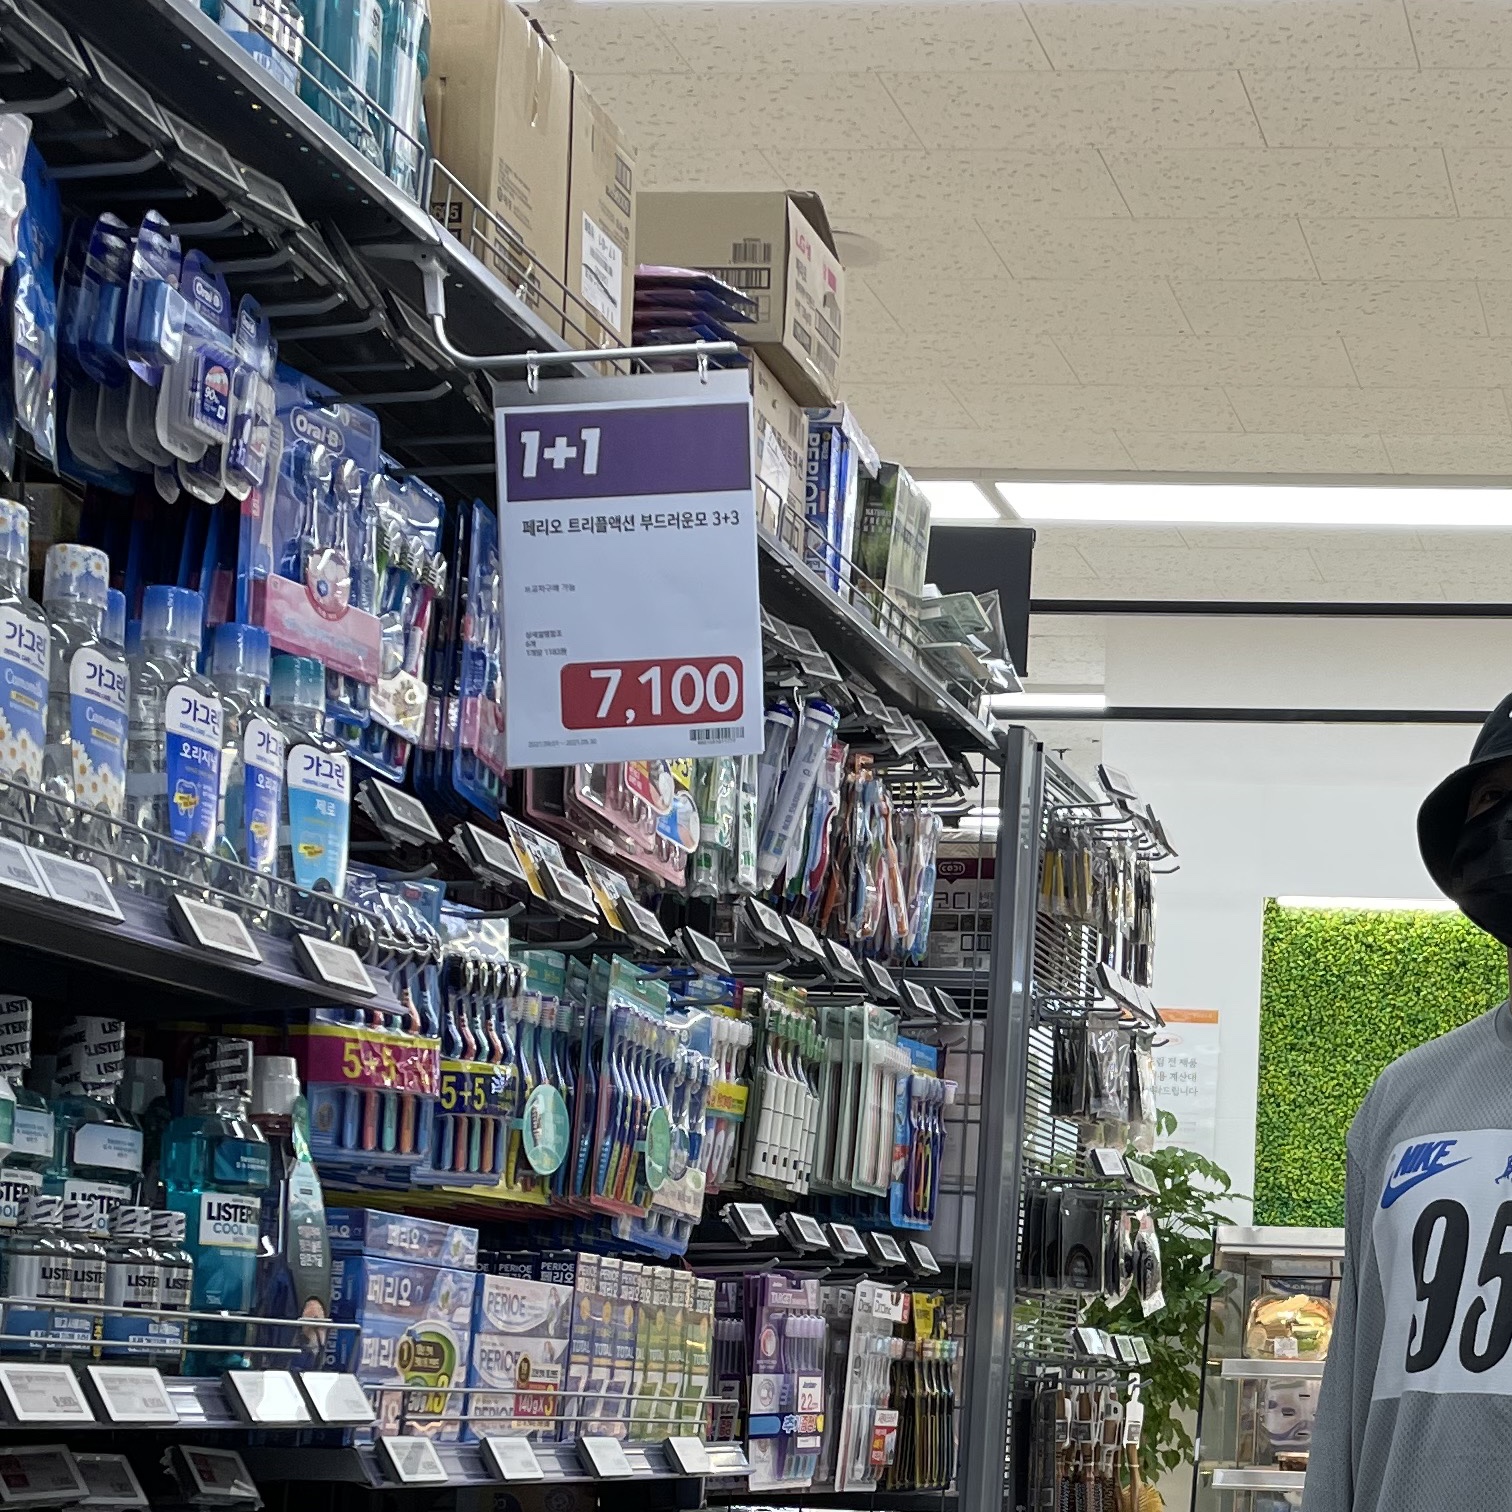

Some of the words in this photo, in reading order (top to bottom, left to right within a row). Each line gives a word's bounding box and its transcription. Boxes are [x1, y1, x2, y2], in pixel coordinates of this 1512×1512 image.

[294, 415, 341, 448] Oral-B
[520, 427, 601, 478] 1+1
[522, 517, 563, 536] 페리오
[567, 512, 636, 535] 트리플액션
[639, 511, 709, 533] 부드러운모
[712, 510, 740, 528] 3+3
[6, 622, 46, 657] 가그린
[86, 662, 127, 699] 가그린
[590, 662, 739, 725] 7,100
[182, 698, 222, 733] 가그린
[303, 755, 345, 787] 가그린
[440, 1074, 486, 1111] 5+5
[1393, 1139, 1458, 1179] NIKE
[206, 1201, 258, 1222] LISTER
[213, 1222, 244, 1234] COOL
[541, 1262, 574, 1272] PERIOE
[541, 1271, 574, 1284] 페리오
[366, 1274, 412, 1307] 페리오
[487, 1292, 527, 1317] PERIOE
[362, 1337, 396, 1367] 페리
